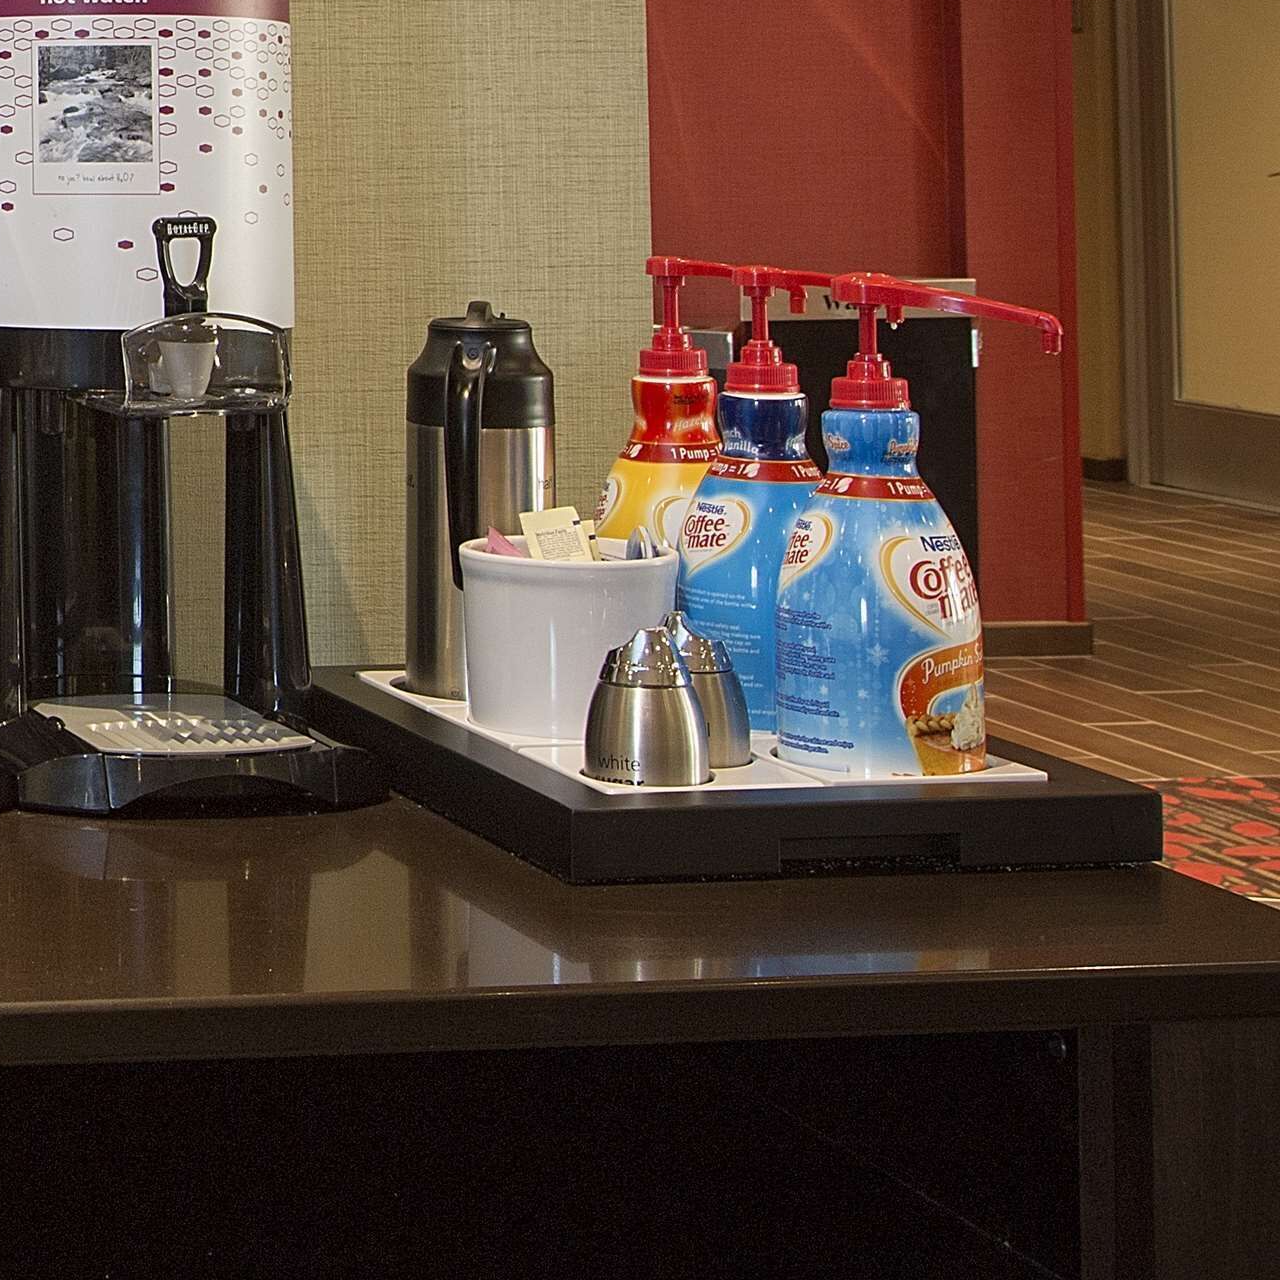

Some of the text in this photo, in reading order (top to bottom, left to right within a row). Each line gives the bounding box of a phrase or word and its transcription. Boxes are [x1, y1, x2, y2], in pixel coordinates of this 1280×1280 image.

[670, 448, 677, 459] 1
[679, 447, 710, 461] Pump
[886, 482, 896, 495] 1
[687, 532, 727, 548] mate
[921, 645, 974, 685] Pumpkin
[598, 754, 641, 772] white
